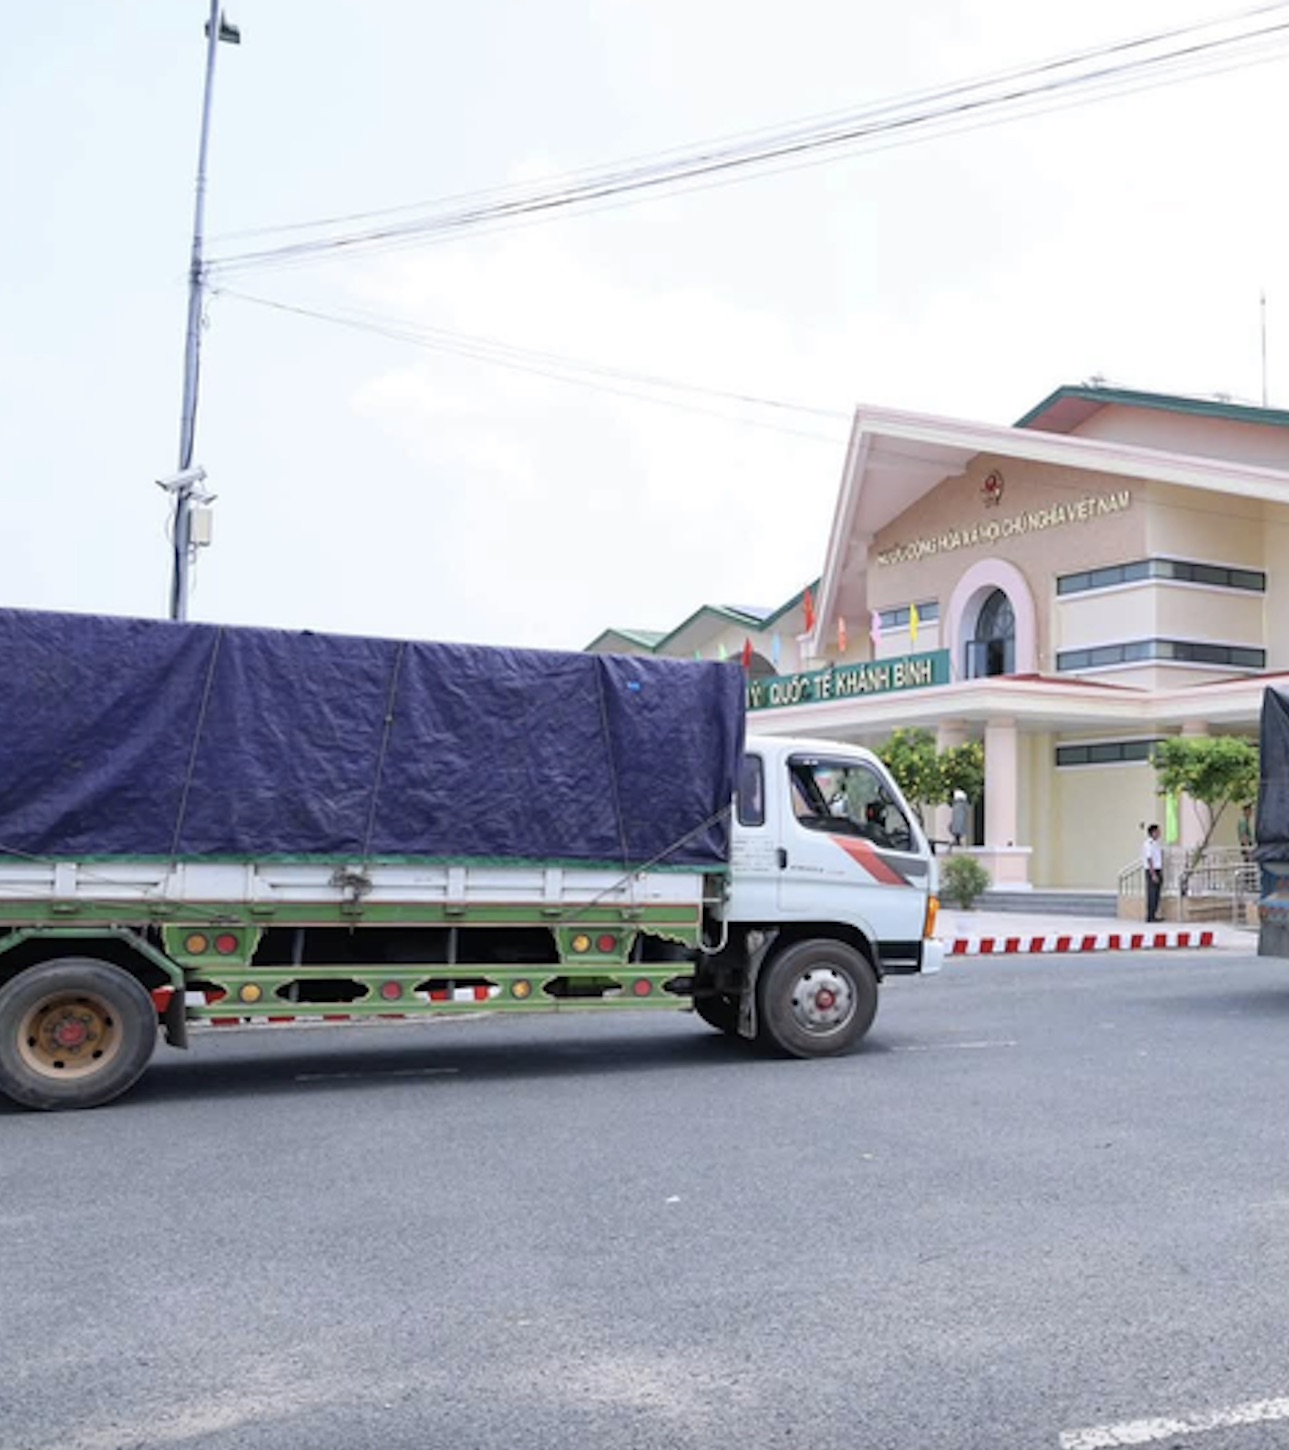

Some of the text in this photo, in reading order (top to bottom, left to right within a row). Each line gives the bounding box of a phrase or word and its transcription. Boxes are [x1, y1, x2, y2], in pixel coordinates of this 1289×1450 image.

[1098, 490, 1130, 515] NAM
[770, 675, 810, 704] QUỐC
[814, 668, 831, 698] TẾ
[836, 664, 890, 696] KHÁNH
[893, 656, 931, 688] BÌNH
